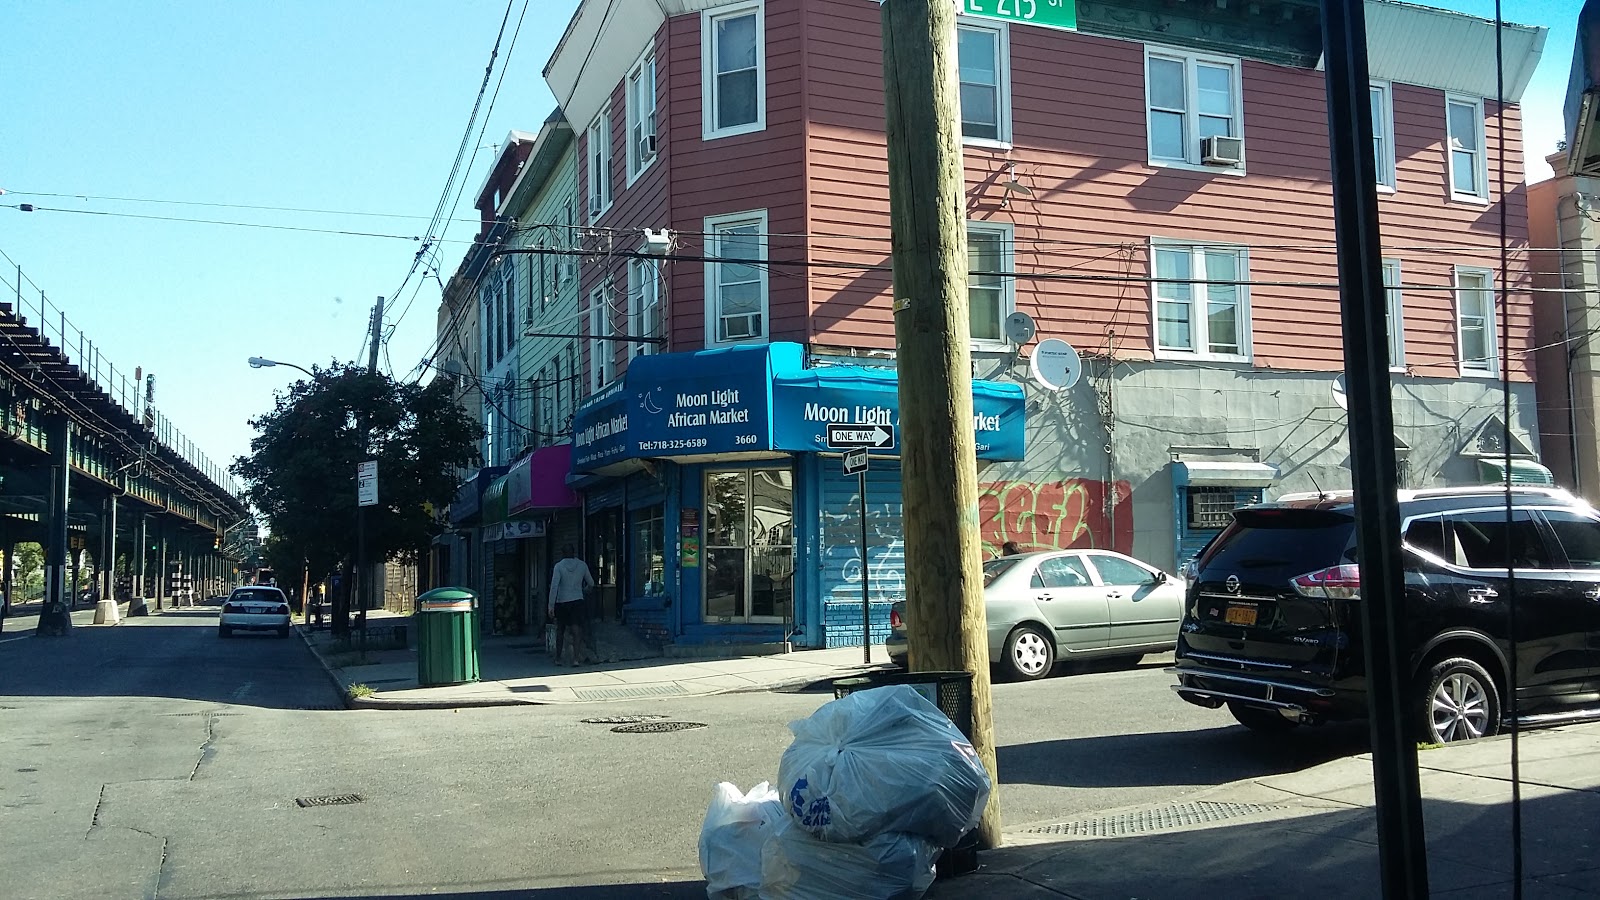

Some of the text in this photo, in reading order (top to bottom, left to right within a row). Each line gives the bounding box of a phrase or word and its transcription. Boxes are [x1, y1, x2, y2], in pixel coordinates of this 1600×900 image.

[676, 389, 740, 408] Moon Light
[668, 408, 749, 428] African Market
[804, 402, 848, 423] Moon
[855, 405, 892, 425] Light
[973, 411, 1001, 431] rket
[735, 434, 757, 445] 3660
[835, 432, 853, 441] ONE
[856, 432, 874, 441] WAY
[638, 438, 708, 450] Tel:718-325-6589
[975, 442, 990, 451] Gari
[850, 455, 865, 466] ONE WAY
